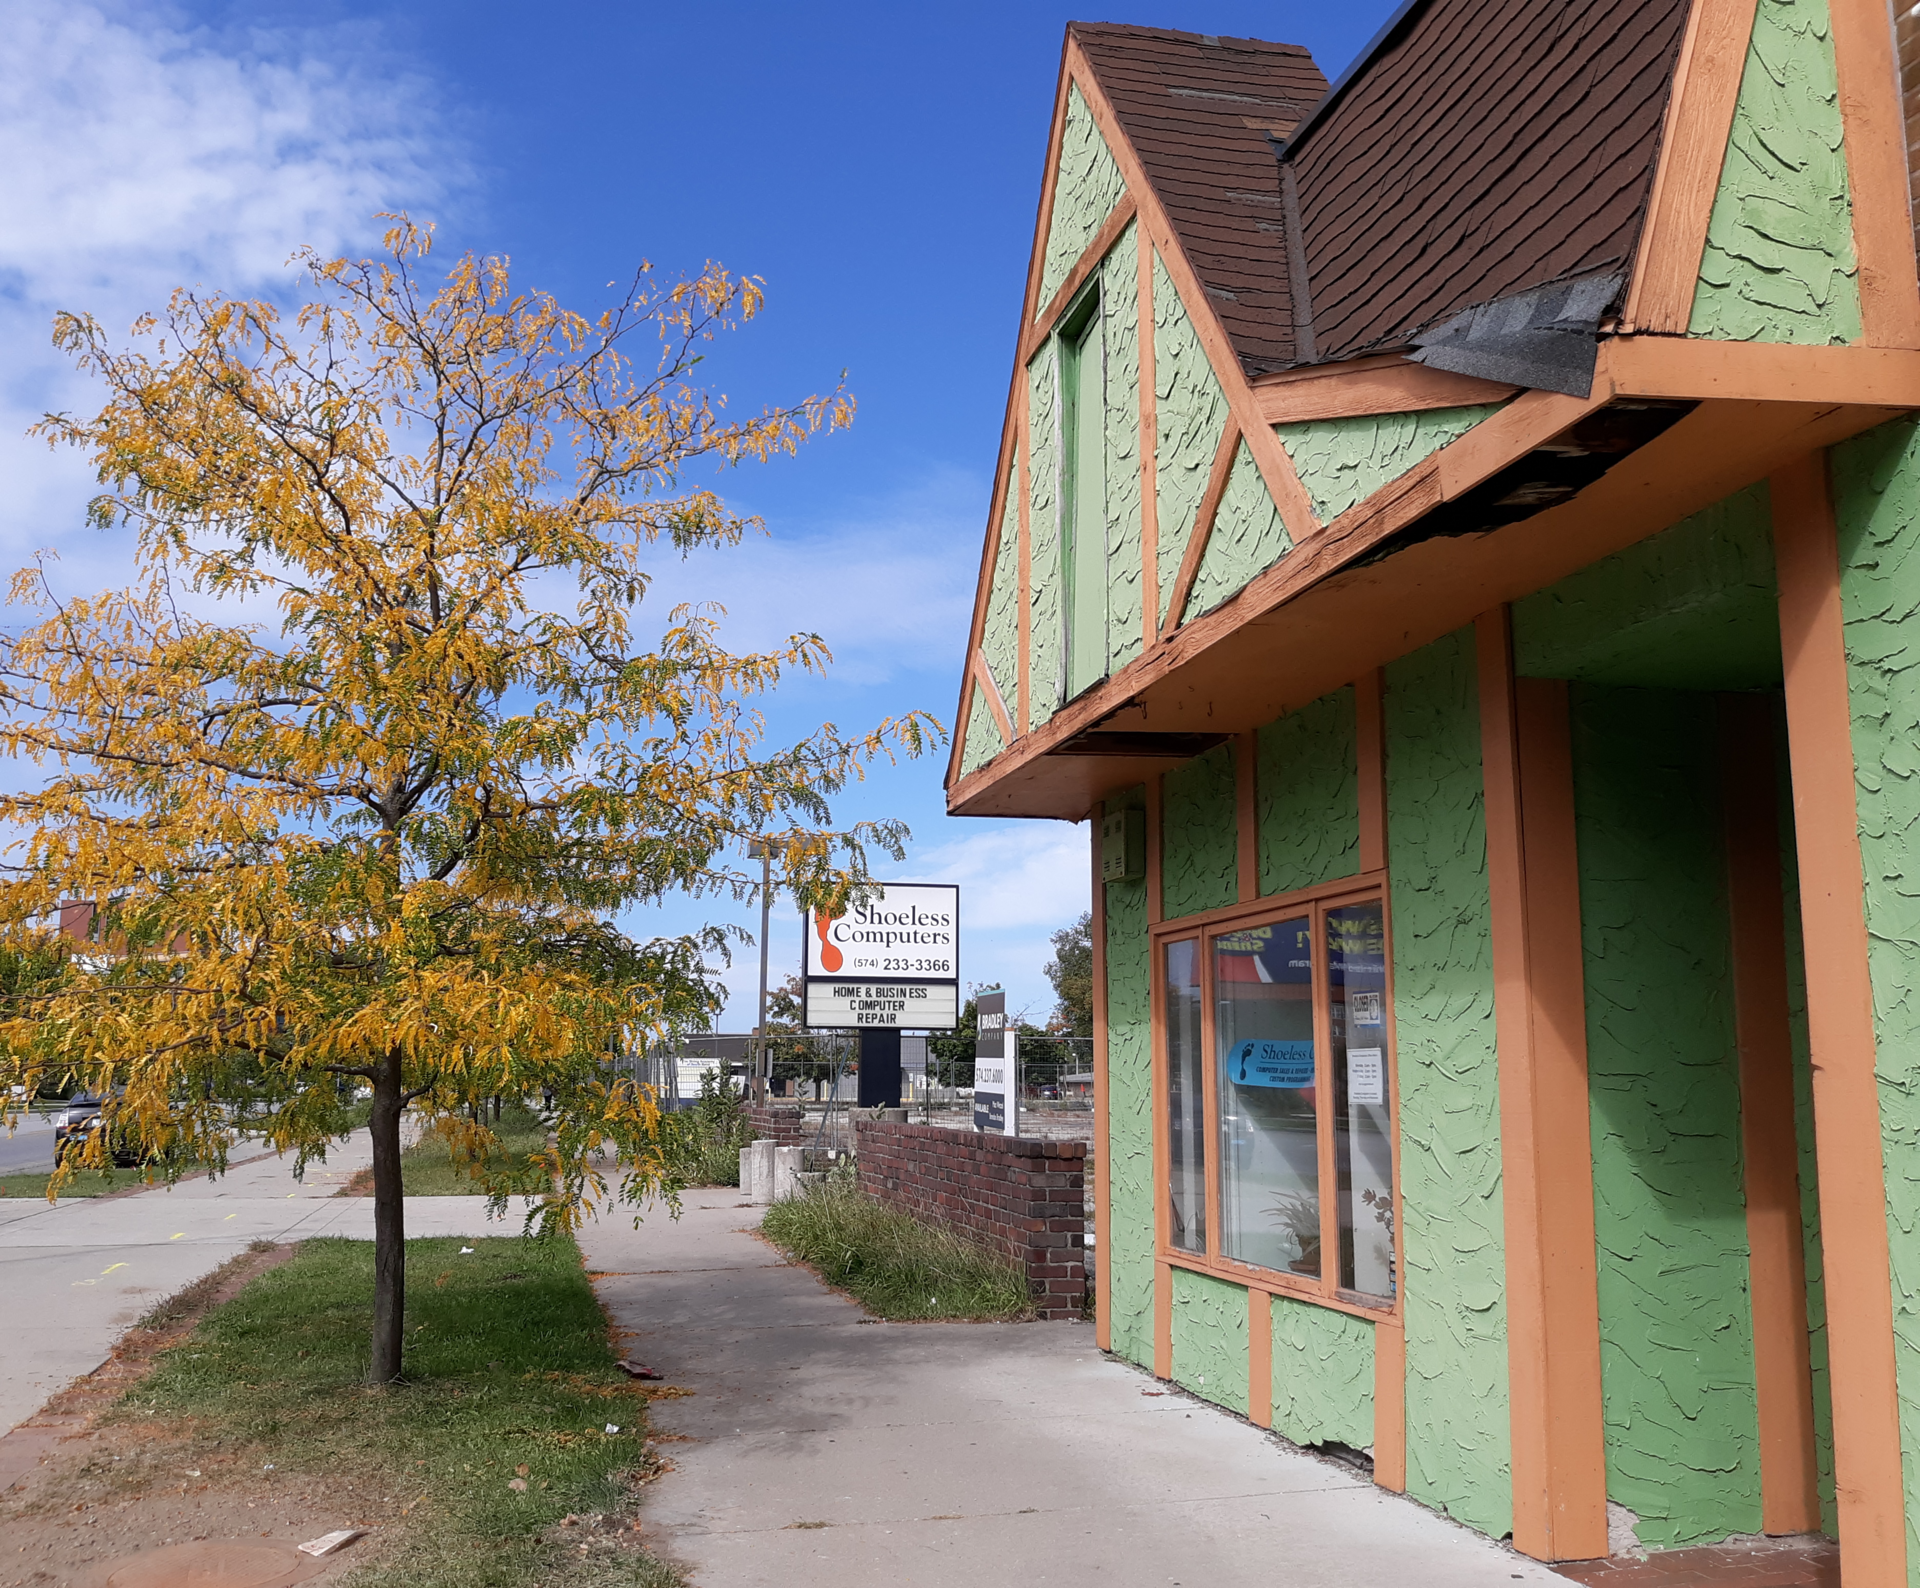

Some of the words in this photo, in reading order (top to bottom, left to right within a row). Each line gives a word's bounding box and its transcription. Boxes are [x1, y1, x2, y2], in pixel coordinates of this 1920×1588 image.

[854, 903, 950, 926] Shoeless
[833, 922, 950, 949] Computers
[853, 957, 879, 969] (574)
[883, 958, 950, 972] 233-3366
[833, 986, 862, 998] HOME
[865, 987, 873, 998] &
[875, 987, 928, 999] BUSINESS
[849, 1000, 905, 1011] COMPUTER
[857, 1013, 897, 1024] REPAIR
[982, 1012, 1003, 1030] BRADLEY
[981, 1032, 1003, 1041] COMPANY
[1260, 1043, 1307, 1061] Shoeless
